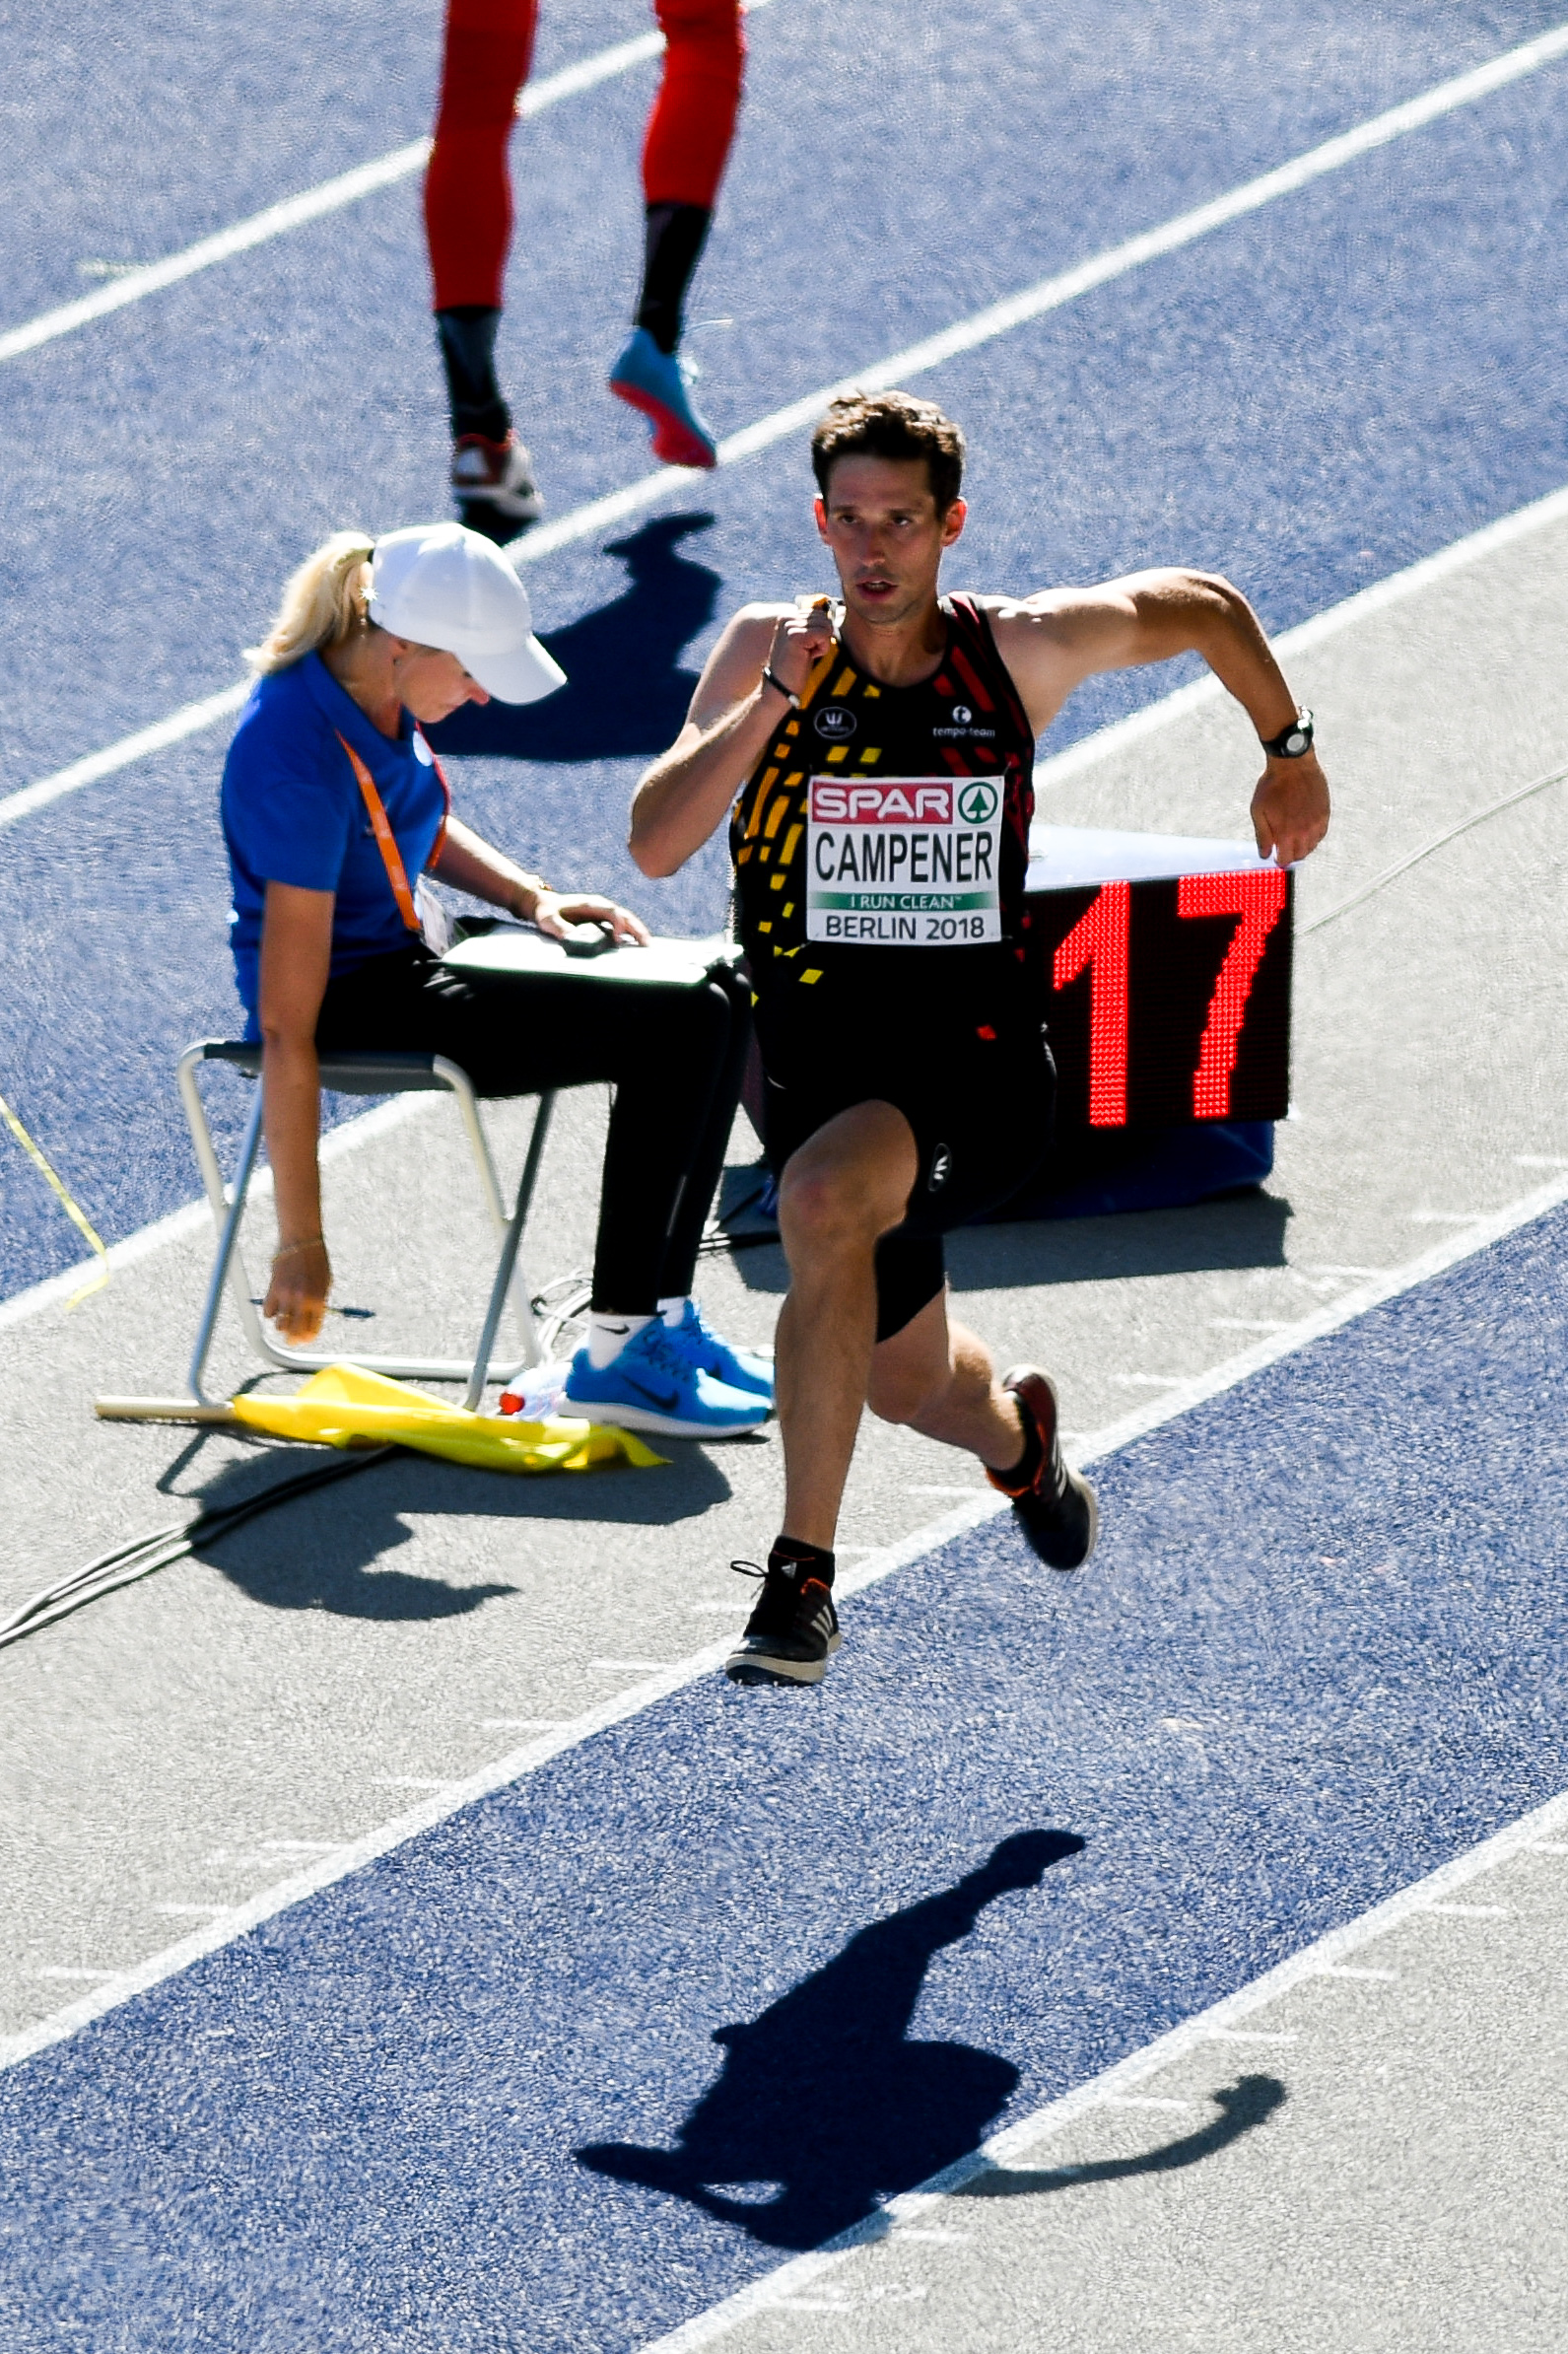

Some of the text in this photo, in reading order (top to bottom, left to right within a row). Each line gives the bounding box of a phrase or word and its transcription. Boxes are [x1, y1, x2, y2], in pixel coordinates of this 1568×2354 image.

[815, 789, 950, 819] SPAR
[815, 831, 992, 882] CAMPENER
[851, 895, 855, 908] I
[860, 895, 895, 909] RUN
[826, 915, 985, 939] BERLIN 2018
[1053, 866, 1285, 1127] 17
